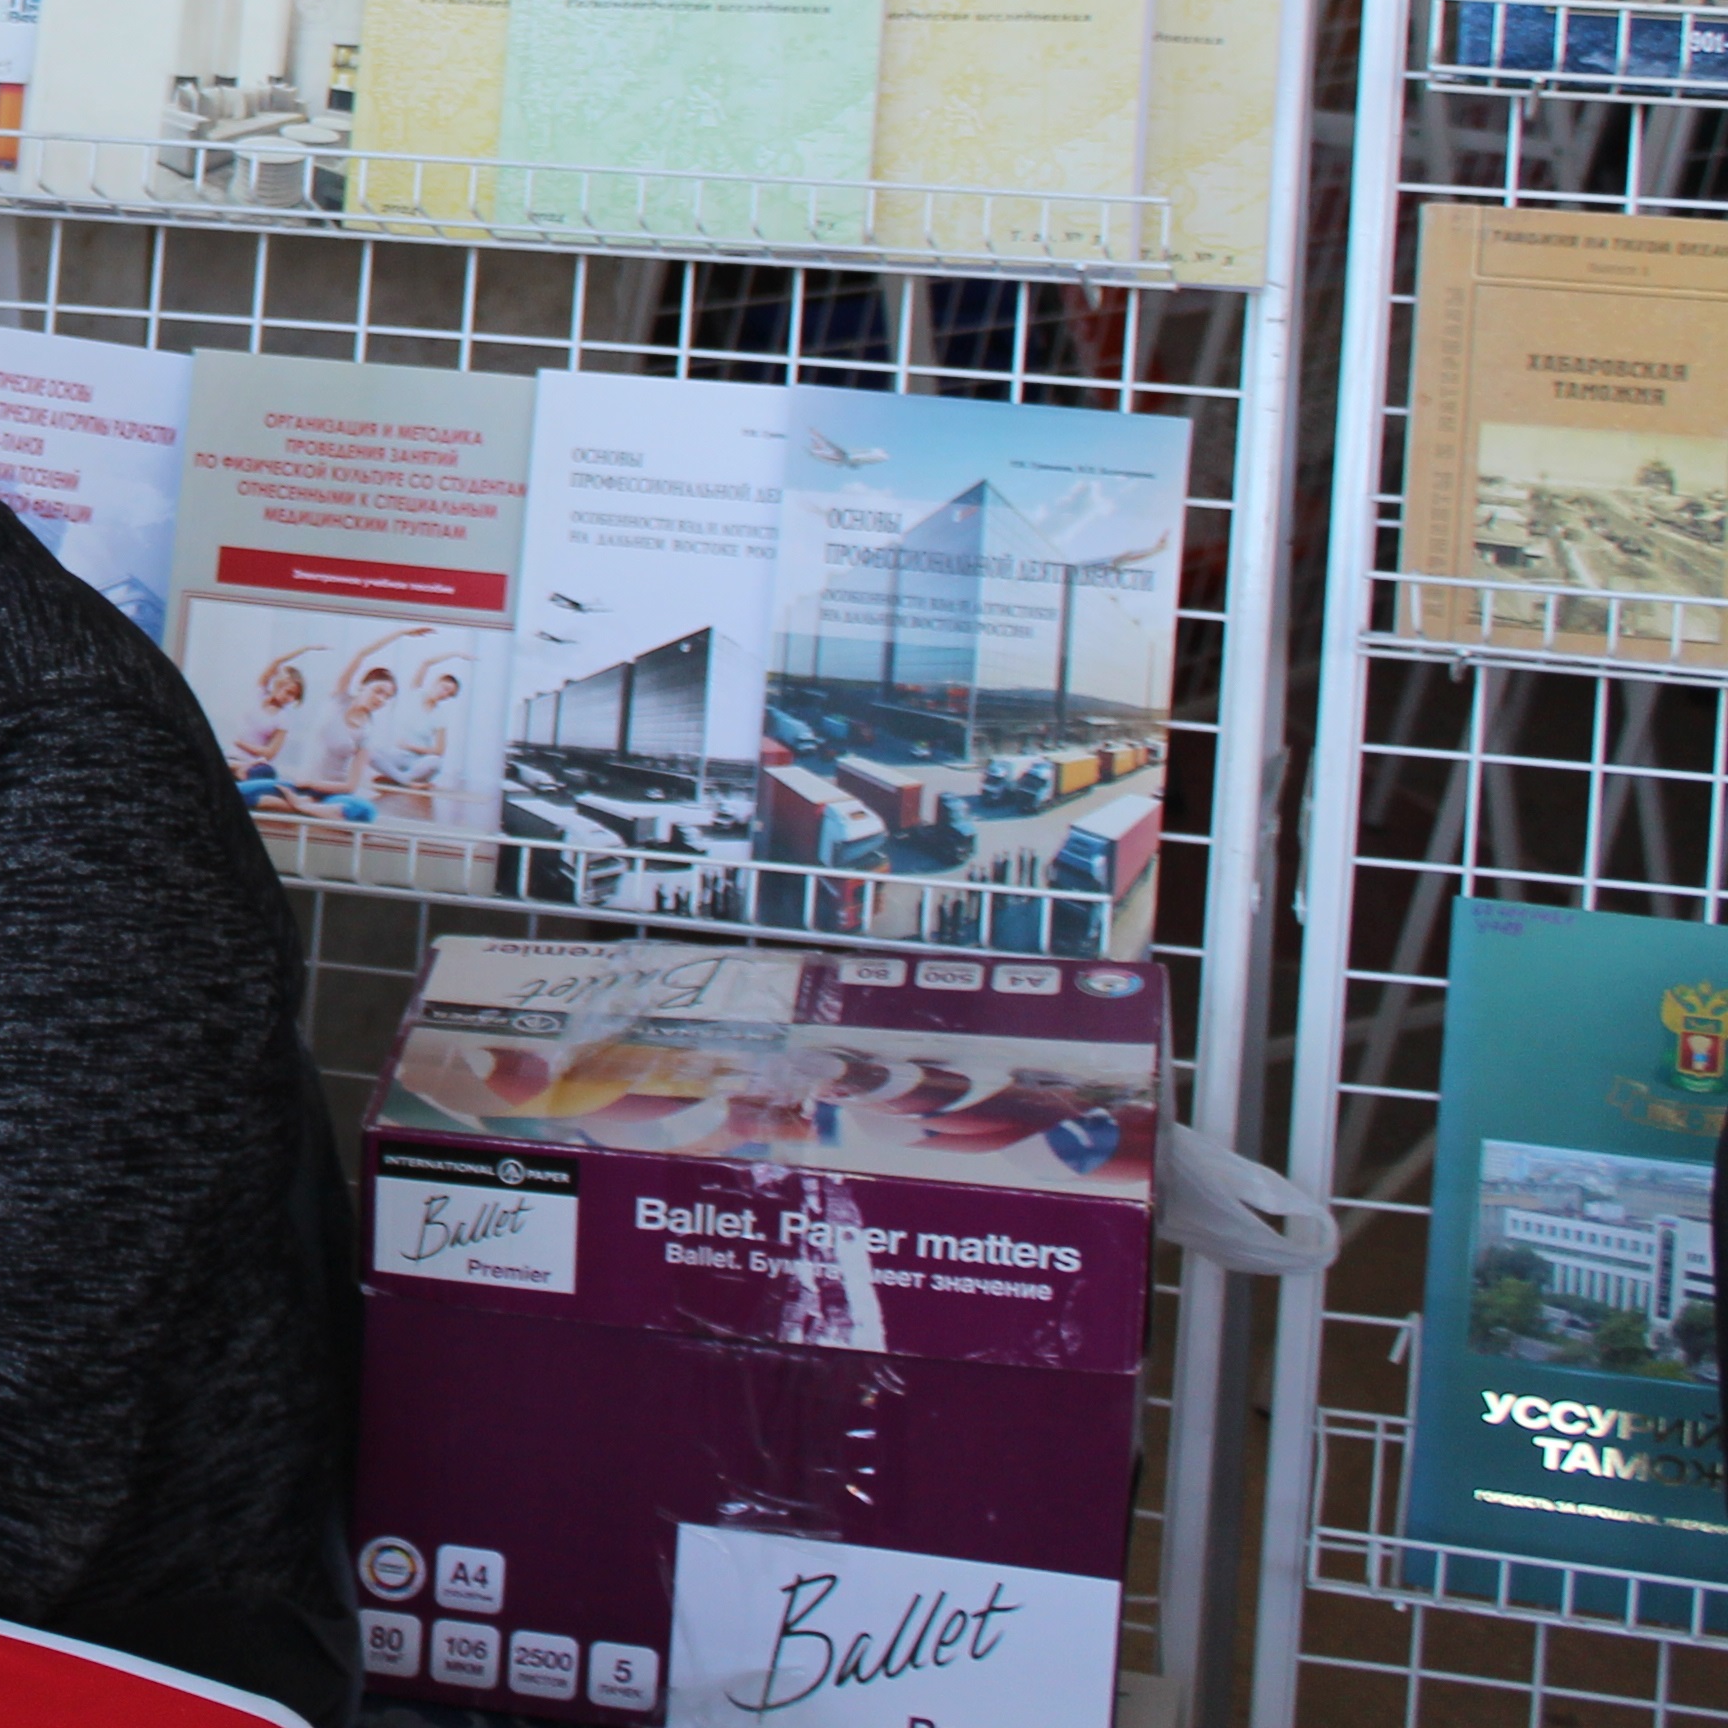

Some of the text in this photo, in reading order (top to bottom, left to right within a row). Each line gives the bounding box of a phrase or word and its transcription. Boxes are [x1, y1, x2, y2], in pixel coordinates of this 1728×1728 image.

[1527, 353, 1690, 382] ХАБАРОВСКАЯ
[1552, 380, 1666, 406] ТАМОЖНЯ
[265, 412, 483, 445] ОРГАНИЗАЦИЯ И МЕТОДИКА
[285, 438, 458, 467] ПРОВЕДЕНИЯ ЗАНЯТИЙ
[194, 452, 434, 490] ПО ФИЗИЧЕСКОЙ КУЛЬТУРЕ СО
[237, 480, 497, 519] ОТНЕСЕННЫМИ К СПЕЦИАЛЬНЫМ
[264, 507, 466, 540] МЕДИЦИНСКИМ ГРУППАМ
[383, 1155, 570, 1184] INTERNATIONAL PAPER
[399, 1194, 536, 1261] Ballet
[634, 1196, 1083, 1273] Ballet. Paper matters
[467, 1258, 551, 1283] Premier
[666, 1242, 1054, 1302] Ballet. значение
[450, 1561, 489, 1589] A4
[370, 1625, 404, 1652] 80
[445, 1636, 488, 1660] 106
[724, 1573, 1025, 1719] Ballet
[515, 1646, 573, 1672] 2500
[613, 1659, 632, 1684] 5
